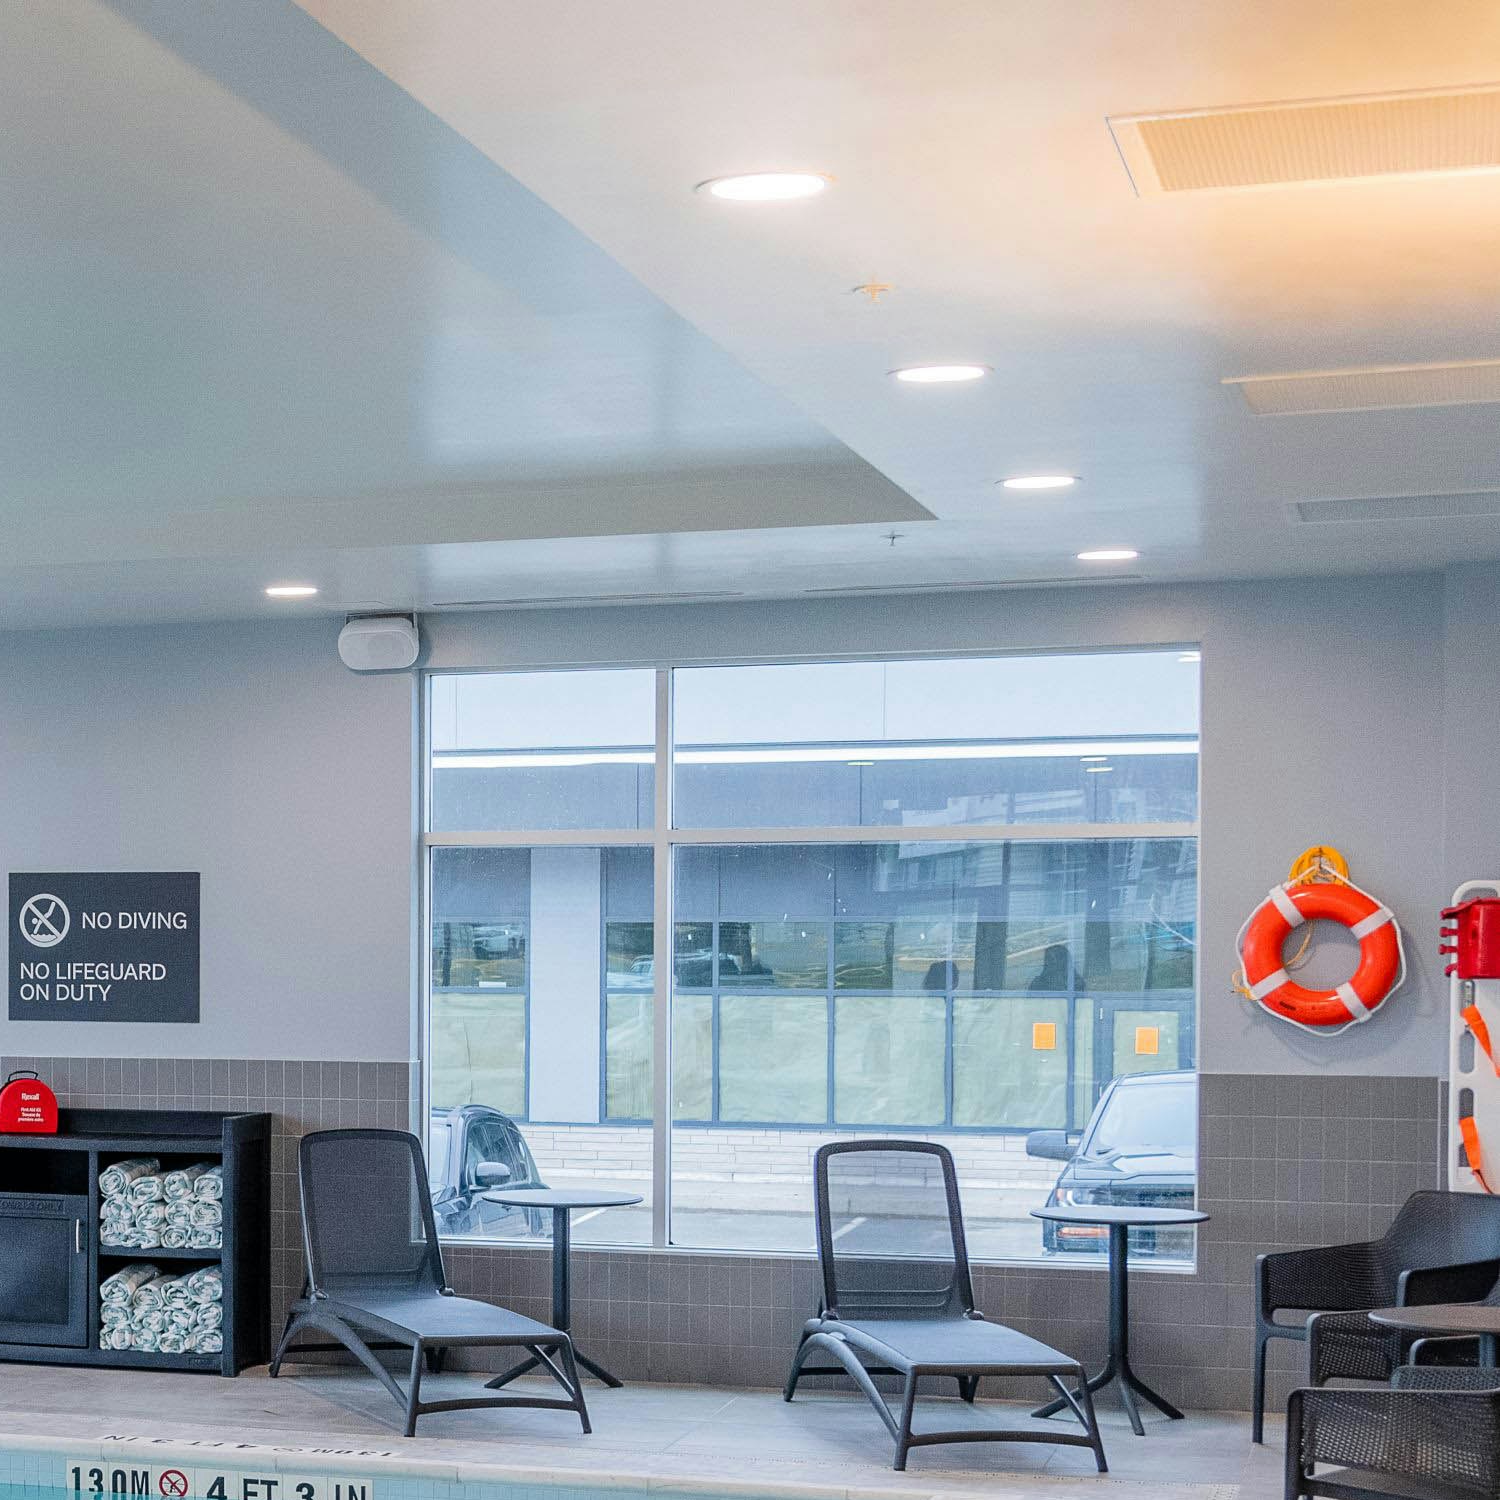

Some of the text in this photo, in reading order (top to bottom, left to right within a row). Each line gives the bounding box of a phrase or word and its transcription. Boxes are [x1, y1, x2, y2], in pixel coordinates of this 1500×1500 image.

[82, 911, 188, 930] NO DIVING
[19, 962, 167, 981] NO LIFEGUARD
[19, 983, 112, 1002] ON DUTY
[206, 1476, 228, 1500] 4
